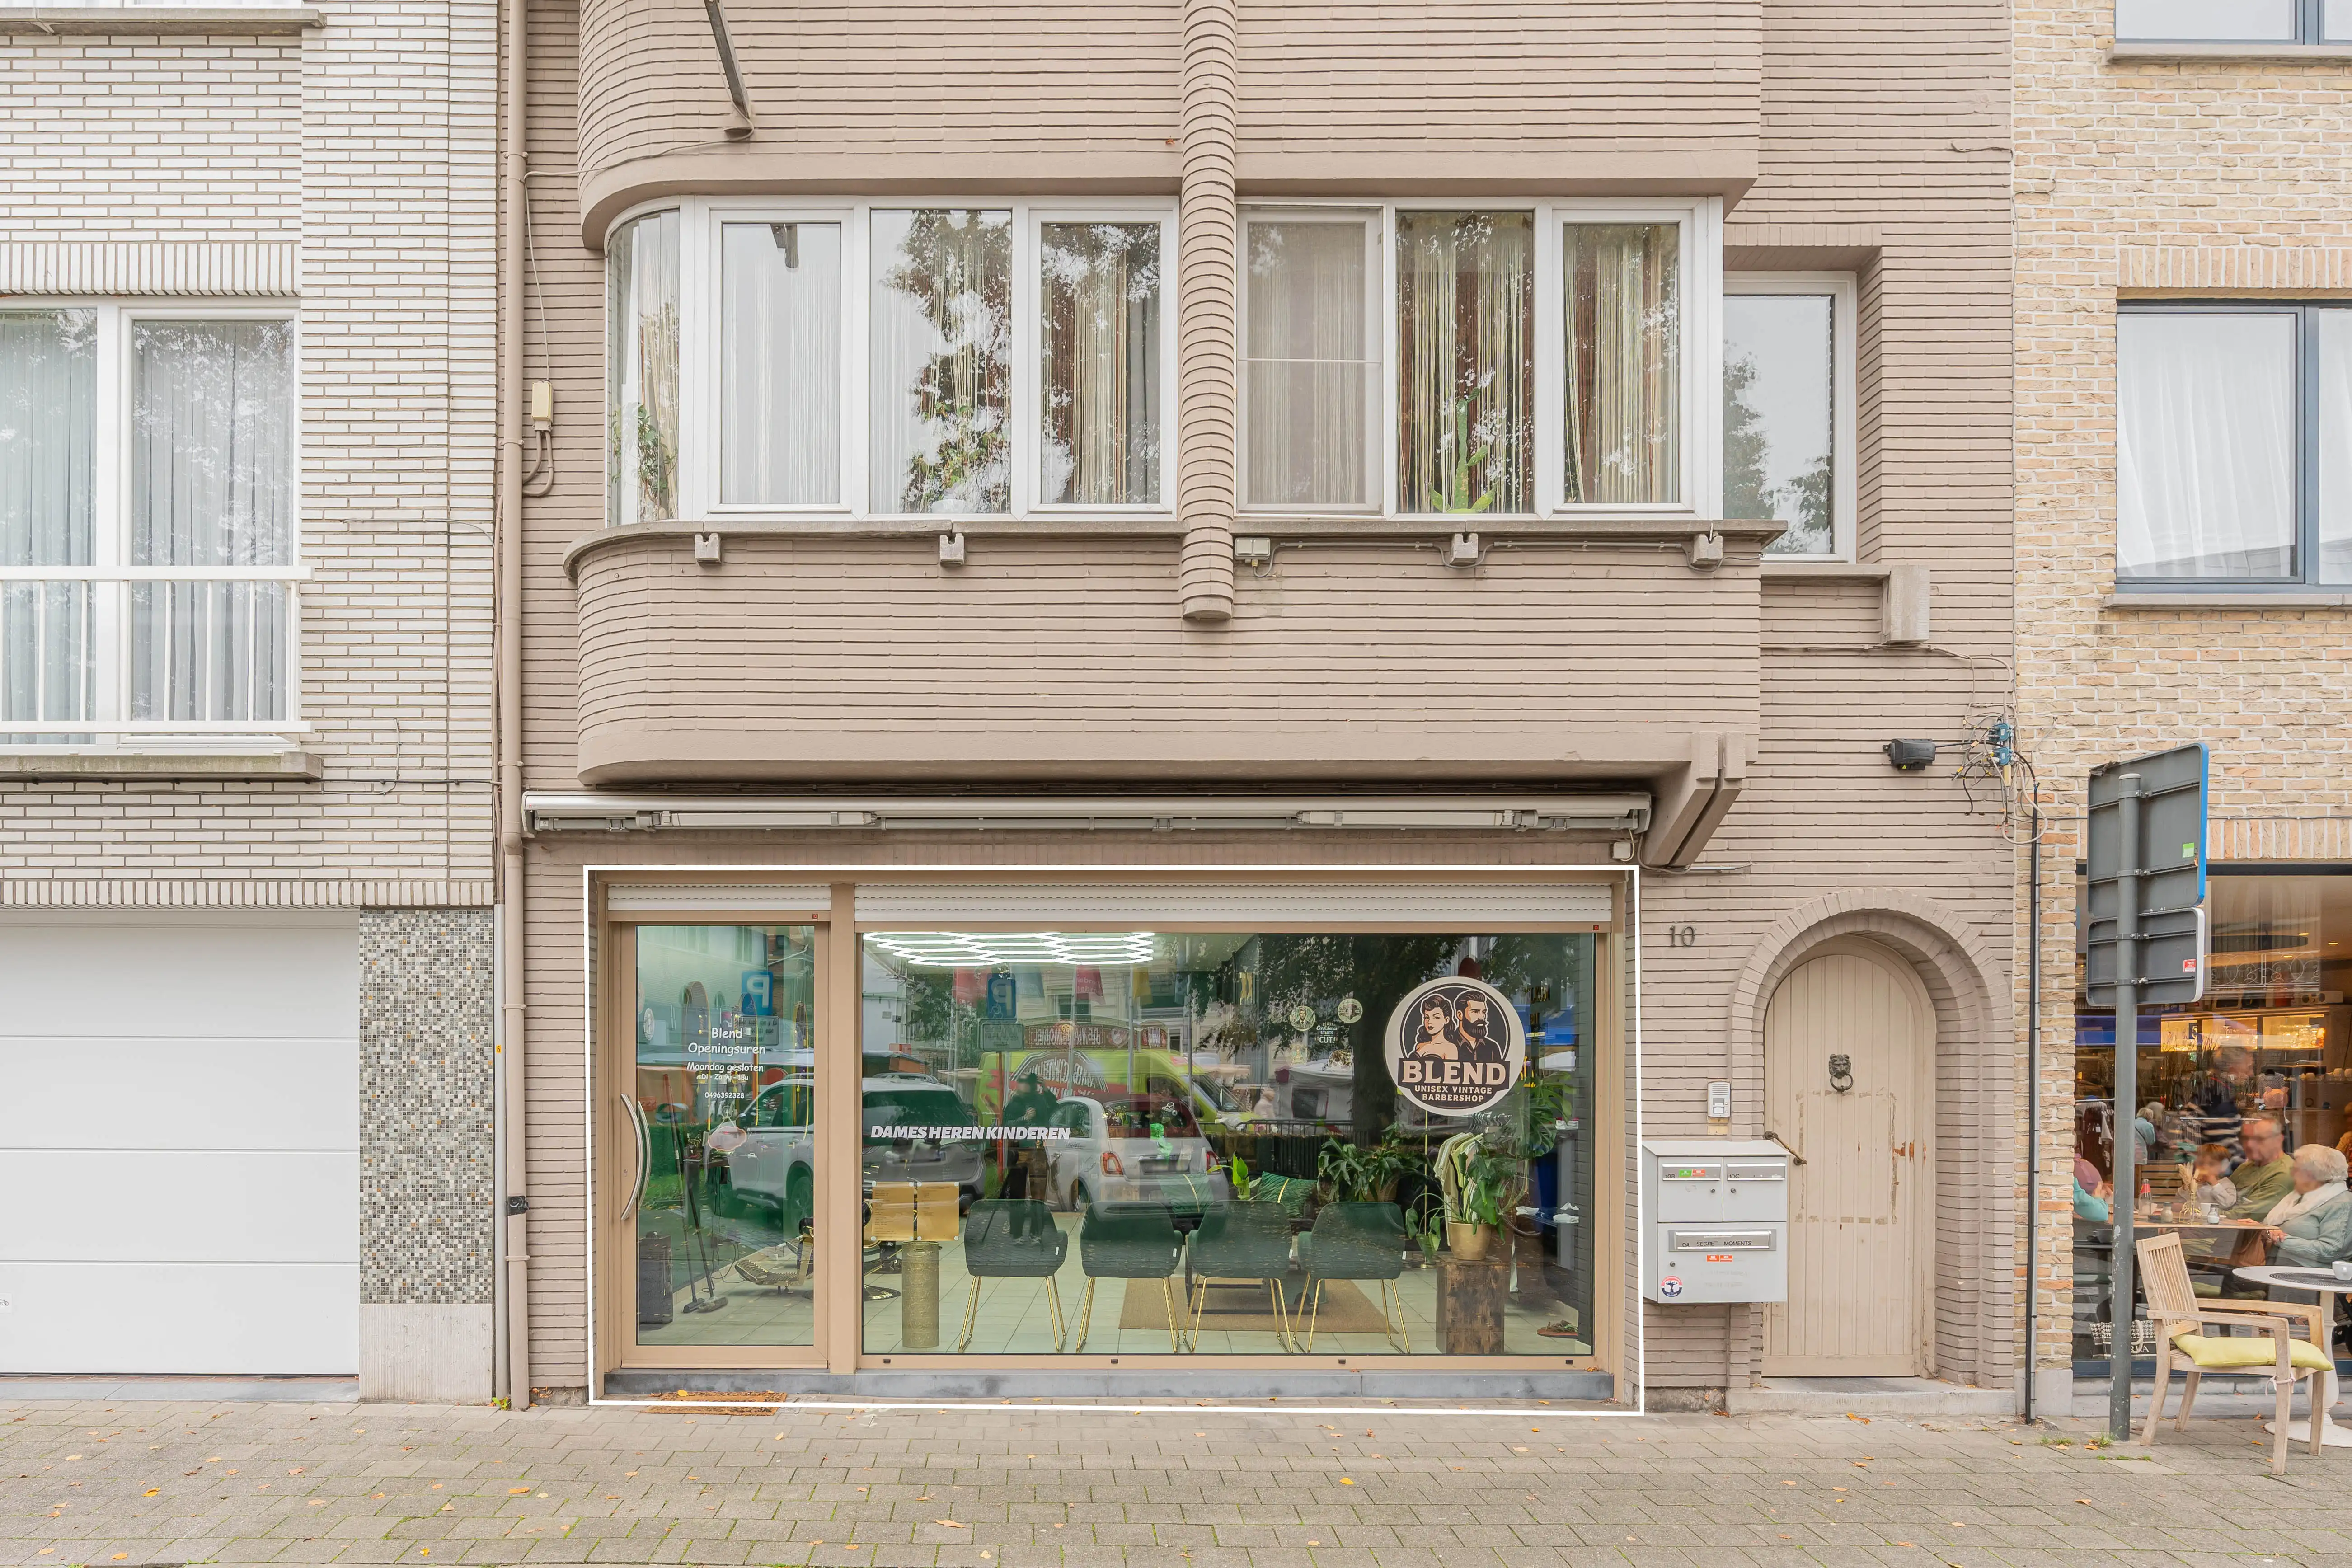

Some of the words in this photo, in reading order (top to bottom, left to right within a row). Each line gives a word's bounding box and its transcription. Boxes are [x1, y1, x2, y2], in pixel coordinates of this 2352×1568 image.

[1670, 925, 1695, 947] 10
[711, 1027, 742, 1038] Blend
[688, 1042, 765, 1056] Openingsuren
[686, 1062, 724, 1073] Maandag
[727, 1062, 764, 1074] gesloten
[1401, 1060, 1506, 1085] BLEND
[1422, 1094, 1484, 1102] BARBERSHOP
[870, 1125, 927, 1138] DAMES
[928, 1126, 984, 1139] HEREN
[986, 1127, 1071, 1140] KINDEREN
